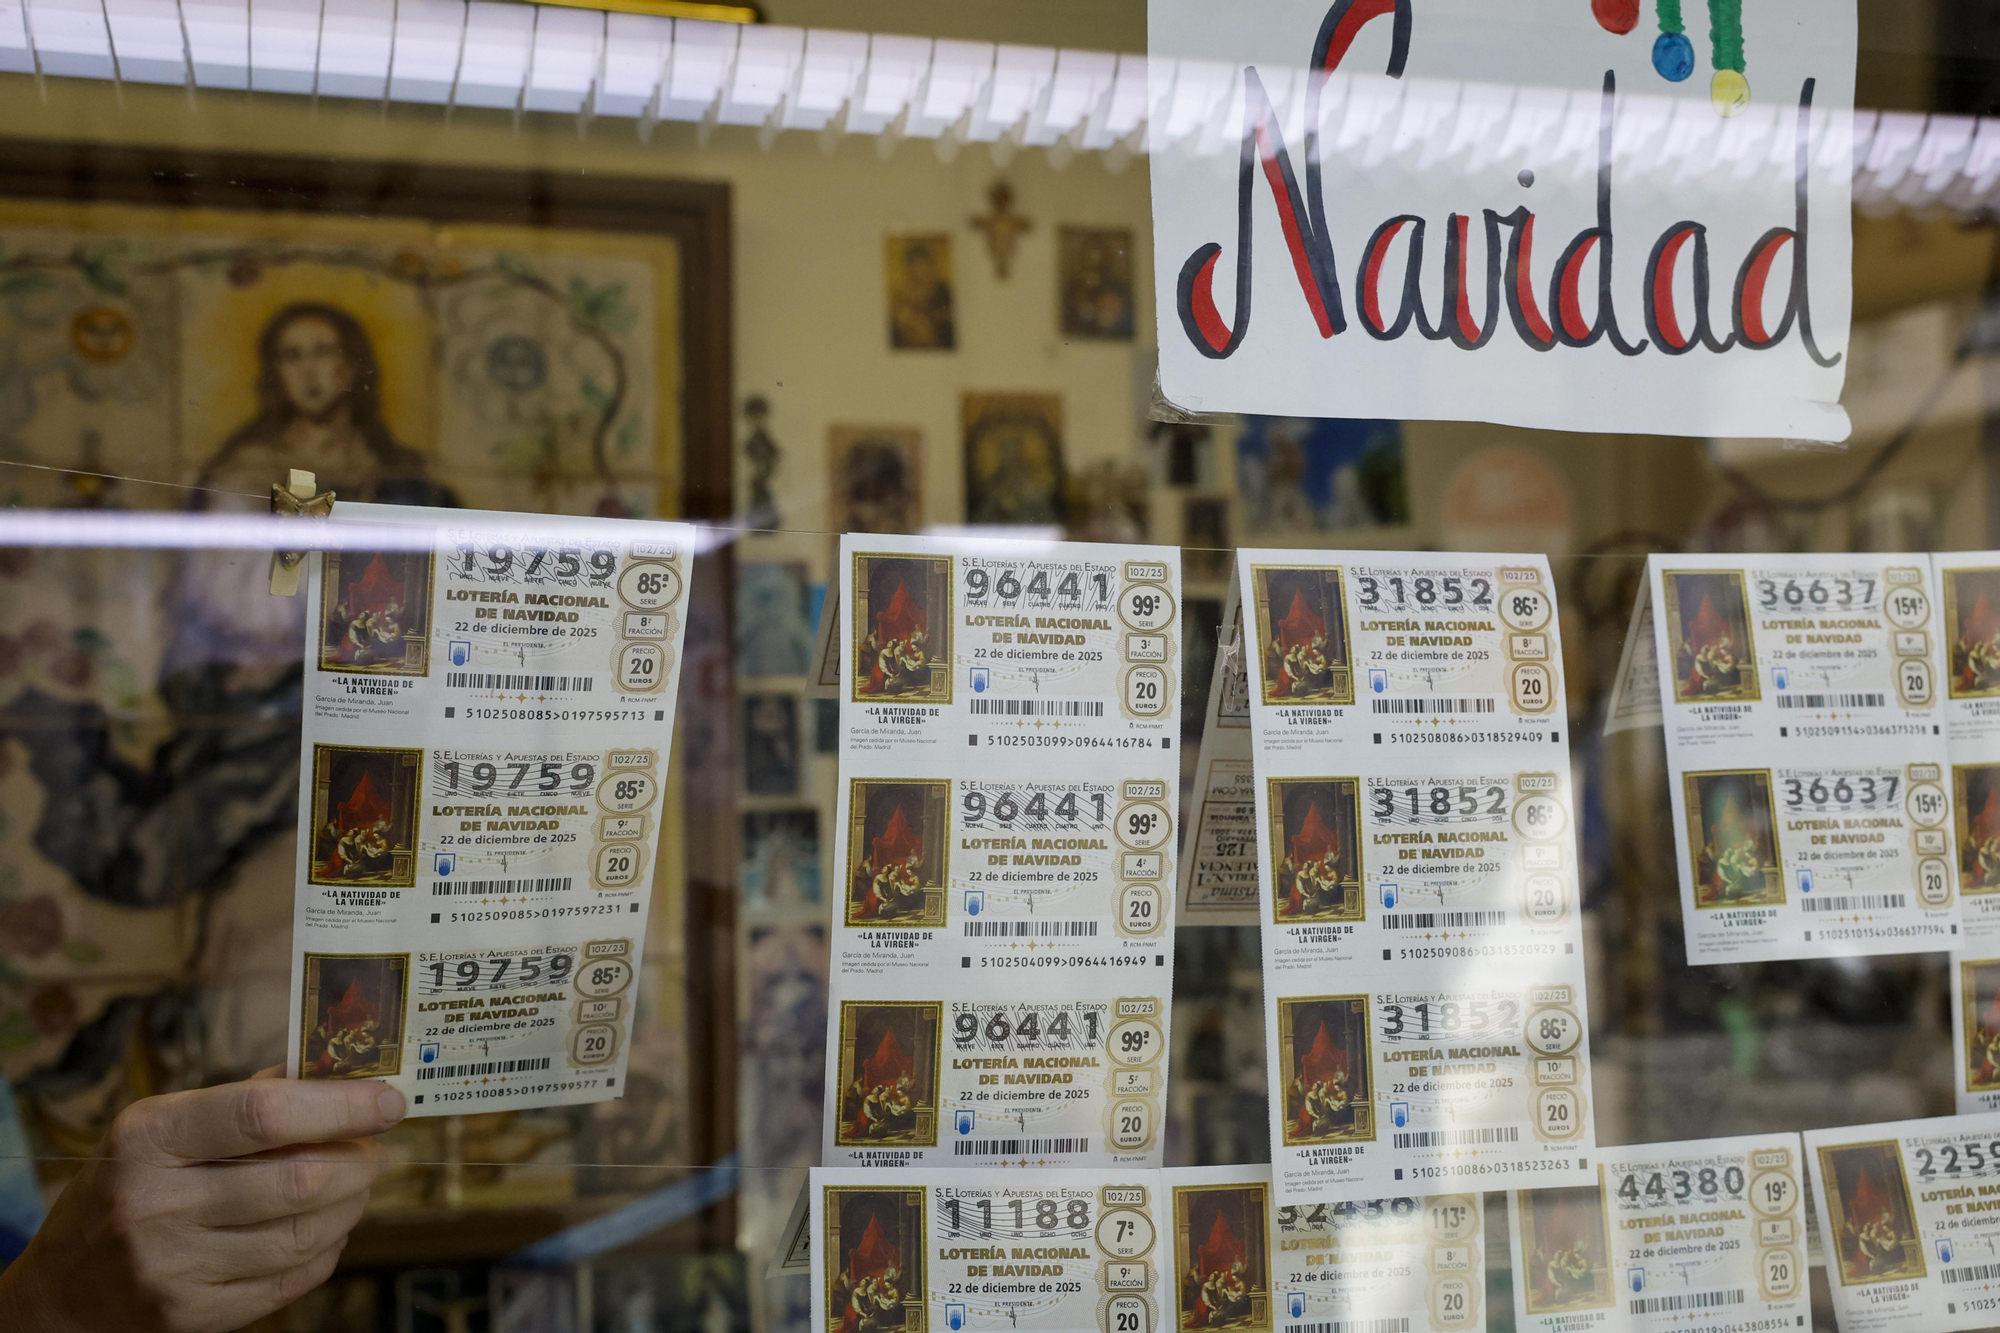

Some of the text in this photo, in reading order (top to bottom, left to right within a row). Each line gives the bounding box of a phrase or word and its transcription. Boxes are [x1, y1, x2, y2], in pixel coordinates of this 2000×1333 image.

[1177, 0, 1842, 368] Navidad
[458, 542, 616, 580] 19759
[1130, 567, 1162, 577] 102/25
[966, 568, 1108, 602] 96441
[1358, 577, 1492, 605] 31852
[447, 588, 610, 607] LOTERÍA NACIONAL
[476, 607, 580, 622] DE NAVIDAD
[966, 614, 1111, 630] LOTERÍA NACIONAL
[1360, 618, 1495, 631] LOTERÍA NACIONAL
[993, 633, 1085, 645] DE NAVIDAD
[1386, 636, 1472, 646] DE NAVIDAD
[974, 649, 1102, 661] 22 de diciembre de 2025
[1131, 650, 1162, 658] FRACCIÓN
[1371, 651, 1489, 660] 22 de diciembre de 2025
[630, 658, 654, 674] 20
[1136, 682, 1156, 699] 20
[1522, 679, 1542, 695] 20
[1906, 675, 1924, 690] 20
[614, 755, 649, 764] 102/25
[442, 762, 595, 790] 19759
[1128, 786, 1160, 795] 102/25
[433, 803, 589, 816] LOTERÍA NACIONAL
[963, 791, 1106, 822] 96441
[1374, 786, 1506, 818] 31852
[461, 819, 560, 830] DE NAVIDAD
[962, 836, 1108, 850] LOTERÍA NACIONAL
[1373, 830, 1508, 845] LOTERÍA NACIONAL
[1216, 842, 1246, 856] 125
[1398, 847, 1485, 859] DE NAVIDAD
[607, 857, 630, 872] 20
[988, 855, 1081, 866] DE NAVIDAD
[1926, 874, 1942, 890] 20
[1533, 890, 1554, 906] 20
[1130, 901, 1151, 917] 20
[429, 954, 573, 986] 19759
[419, 992, 567, 1012] LOTERÍA NACIONAL
[445, 1007, 540, 1022] DE NAVIDAD
[1383, 1000, 1518, 1035] 31852
[954, 1011, 1098, 1042] 96441
[584, 1037, 606, 1051] 20
[1383, 1045, 1520, 1063] LOTERÍA NACIONAL
[953, 1056, 1100, 1070] LOTERÍA NACIONAL
[1409, 1062, 1496, 1077] DE NAVIDAD
[979, 1073, 1073, 1085] DE NAVIDAD
[1547, 1104, 1568, 1121] 20
[1121, 1116, 1142, 1133] 20
[1618, 1166, 1745, 1203] 44380
[944, 1198, 1090, 1230] 11188
[1619, 1209, 1745, 1230] LOTERÍA NACIONAL
[1644, 1226, 1724, 1243] DE NAVIDAD
[940, 1246, 1090, 1261] LOTERÍA NACIONAL
[968, 1265, 1063, 1277] DE NAVIDAD
[1770, 1264, 1788, 1282] 20
[949, 1282, 1081, 1293] 22 de diciembre de 2025
[1443, 1293, 1464, 1311] 20
[1117, 1313, 1139, 1331] 20
